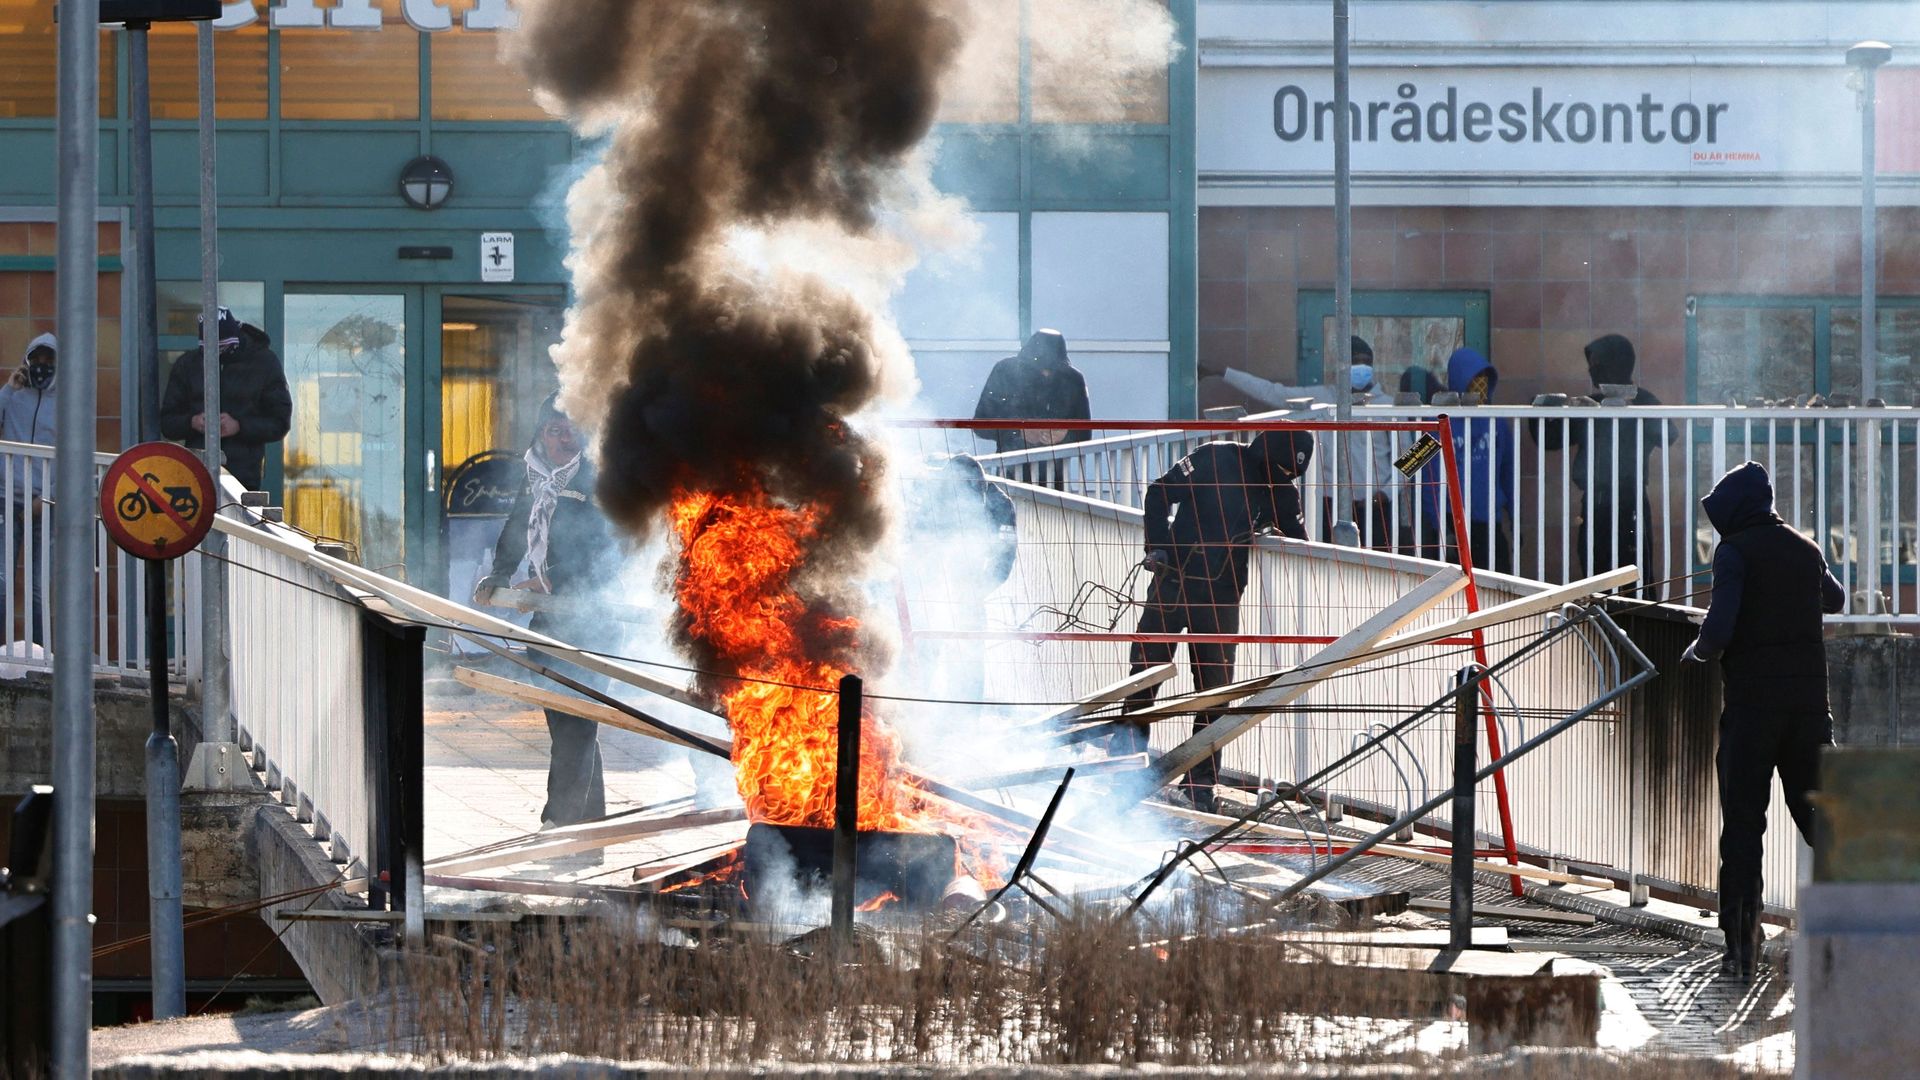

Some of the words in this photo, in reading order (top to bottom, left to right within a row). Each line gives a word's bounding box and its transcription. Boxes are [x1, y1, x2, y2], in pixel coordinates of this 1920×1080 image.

[1273, 83, 1729, 144] Områdeskontor
[1693, 151, 1707, 160] DU
[1725, 151, 1761, 160] HEMMA
